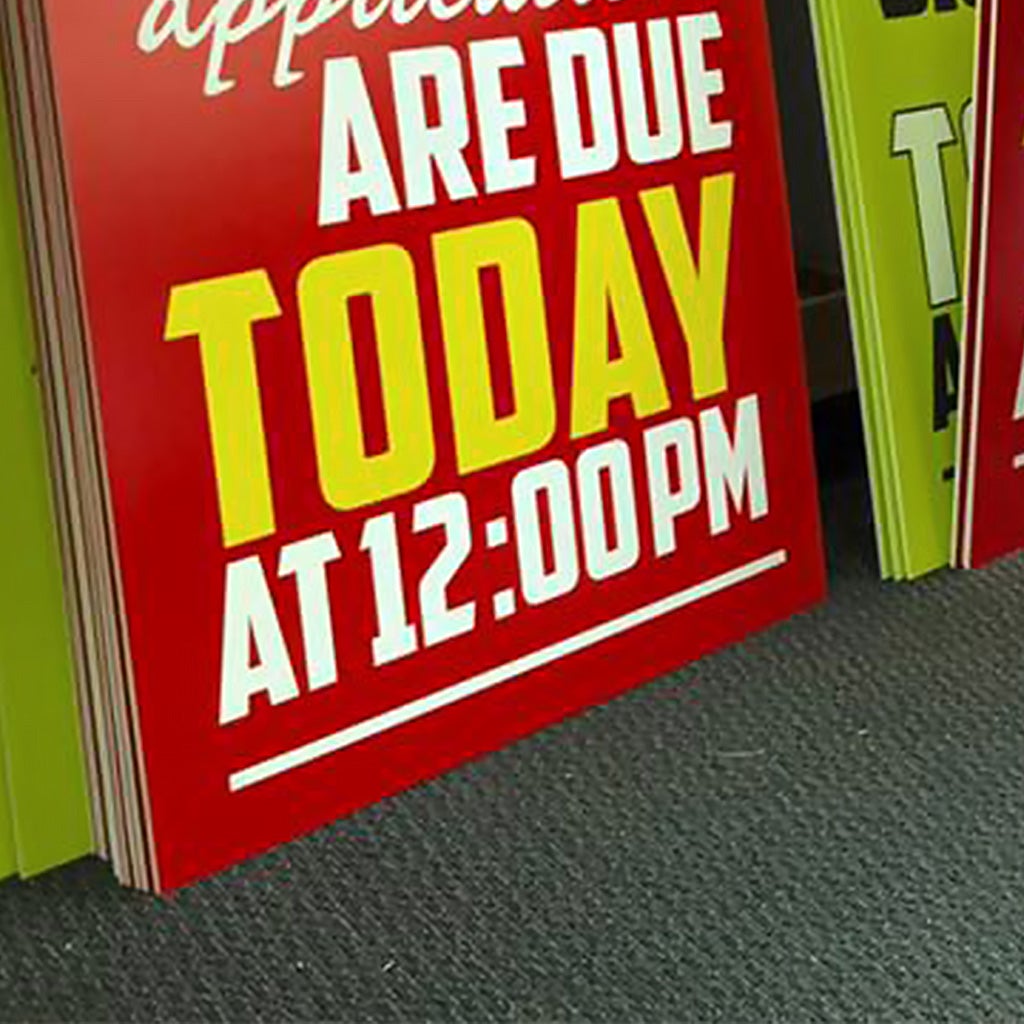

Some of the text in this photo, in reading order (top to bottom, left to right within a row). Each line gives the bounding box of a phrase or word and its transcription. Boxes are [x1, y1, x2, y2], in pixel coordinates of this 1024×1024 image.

[319, 13, 733, 227] ARE DUE
[163, 172, 735, 548] TODAY
[218, 532, 343, 726] AT
